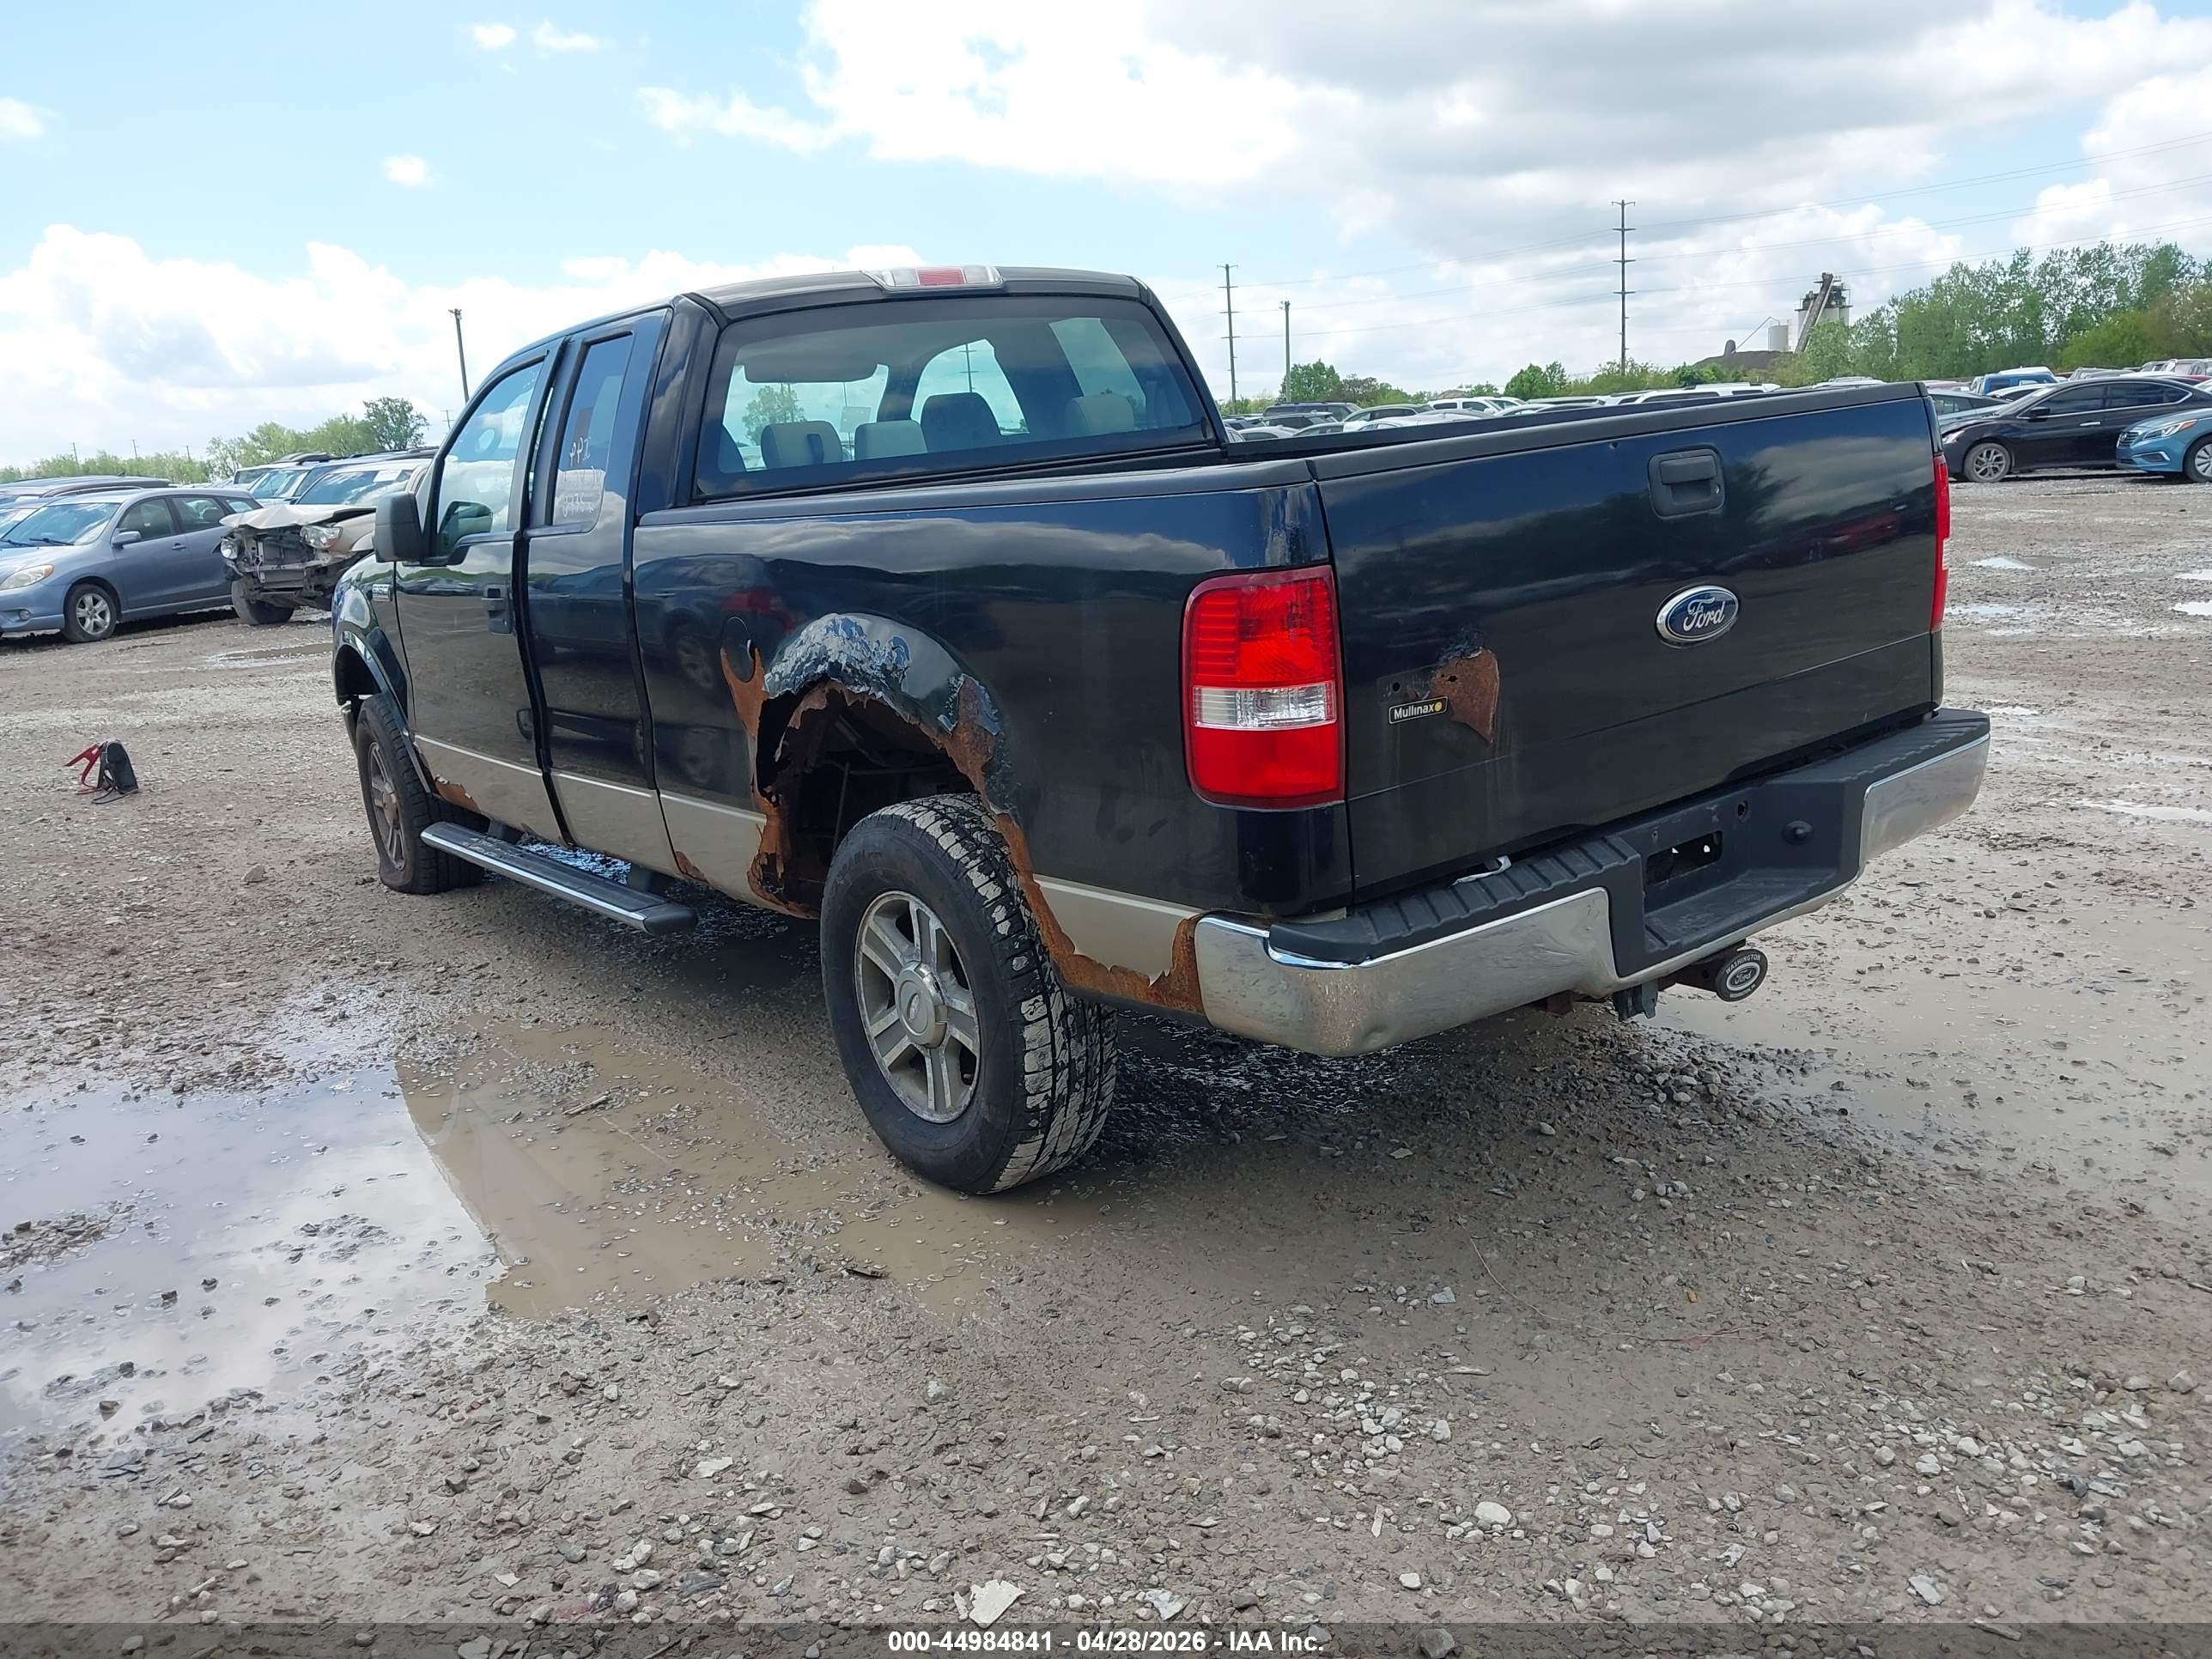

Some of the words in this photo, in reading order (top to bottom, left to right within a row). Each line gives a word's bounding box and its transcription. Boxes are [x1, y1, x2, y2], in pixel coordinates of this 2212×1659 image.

[1683, 597, 1725, 631] Ford
[1394, 703, 1434, 720] Mullinax
[1725, 953, 1761, 975] WASHINGTON
[1735, 969, 1753, 984] Ford
